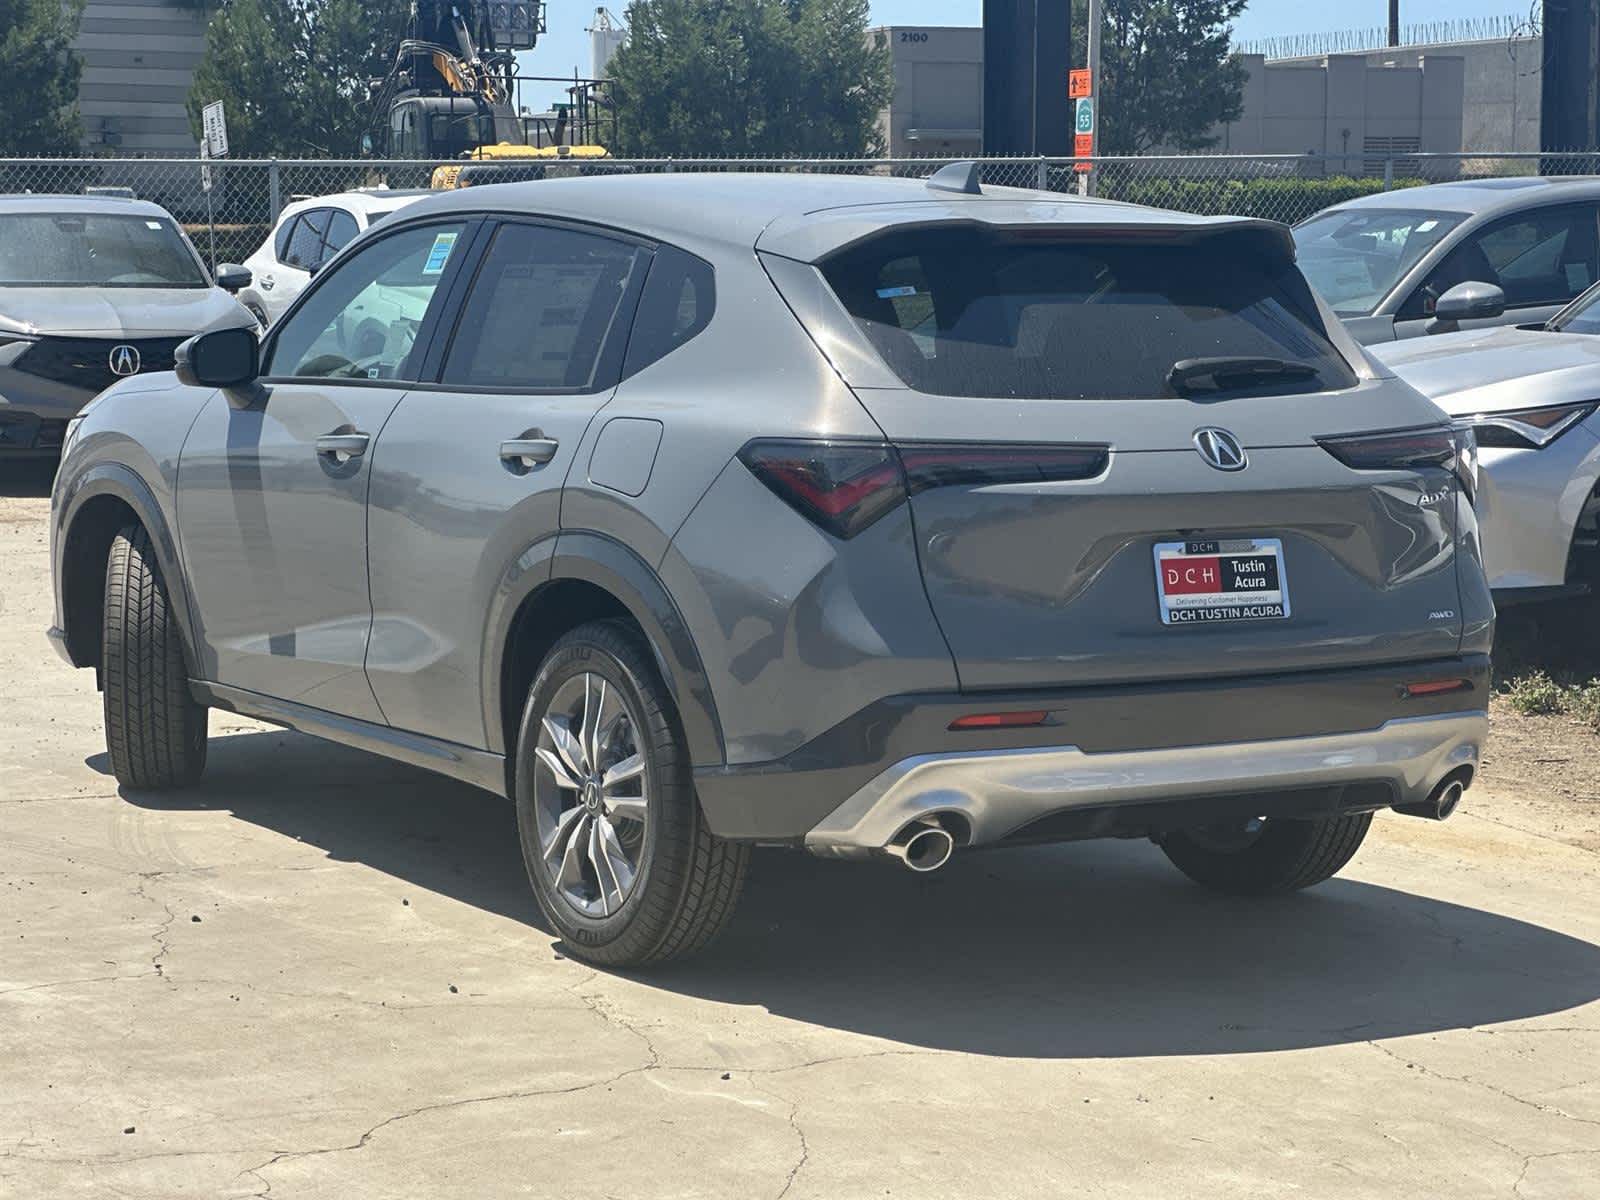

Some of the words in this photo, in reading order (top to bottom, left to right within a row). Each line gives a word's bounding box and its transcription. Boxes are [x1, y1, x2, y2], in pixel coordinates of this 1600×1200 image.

[901, 32, 929, 43] 2100
[1079, 115, 1090, 128] 55
[1418, 490, 1447, 506] ADX
[1191, 543, 1214, 553] DCH
[1231, 560, 1266, 573] Tustin
[1234, 575, 1267, 588] Acura
[1175, 597, 1207, 606] Delivering
[1208, 596, 1237, 605] Customer
[1170, 610, 1196, 621] DCH
[1198, 608, 1241, 620] TUSTIN
[1242, 605, 1283, 617] ACURA
[1428, 610, 1454, 620] AWD
